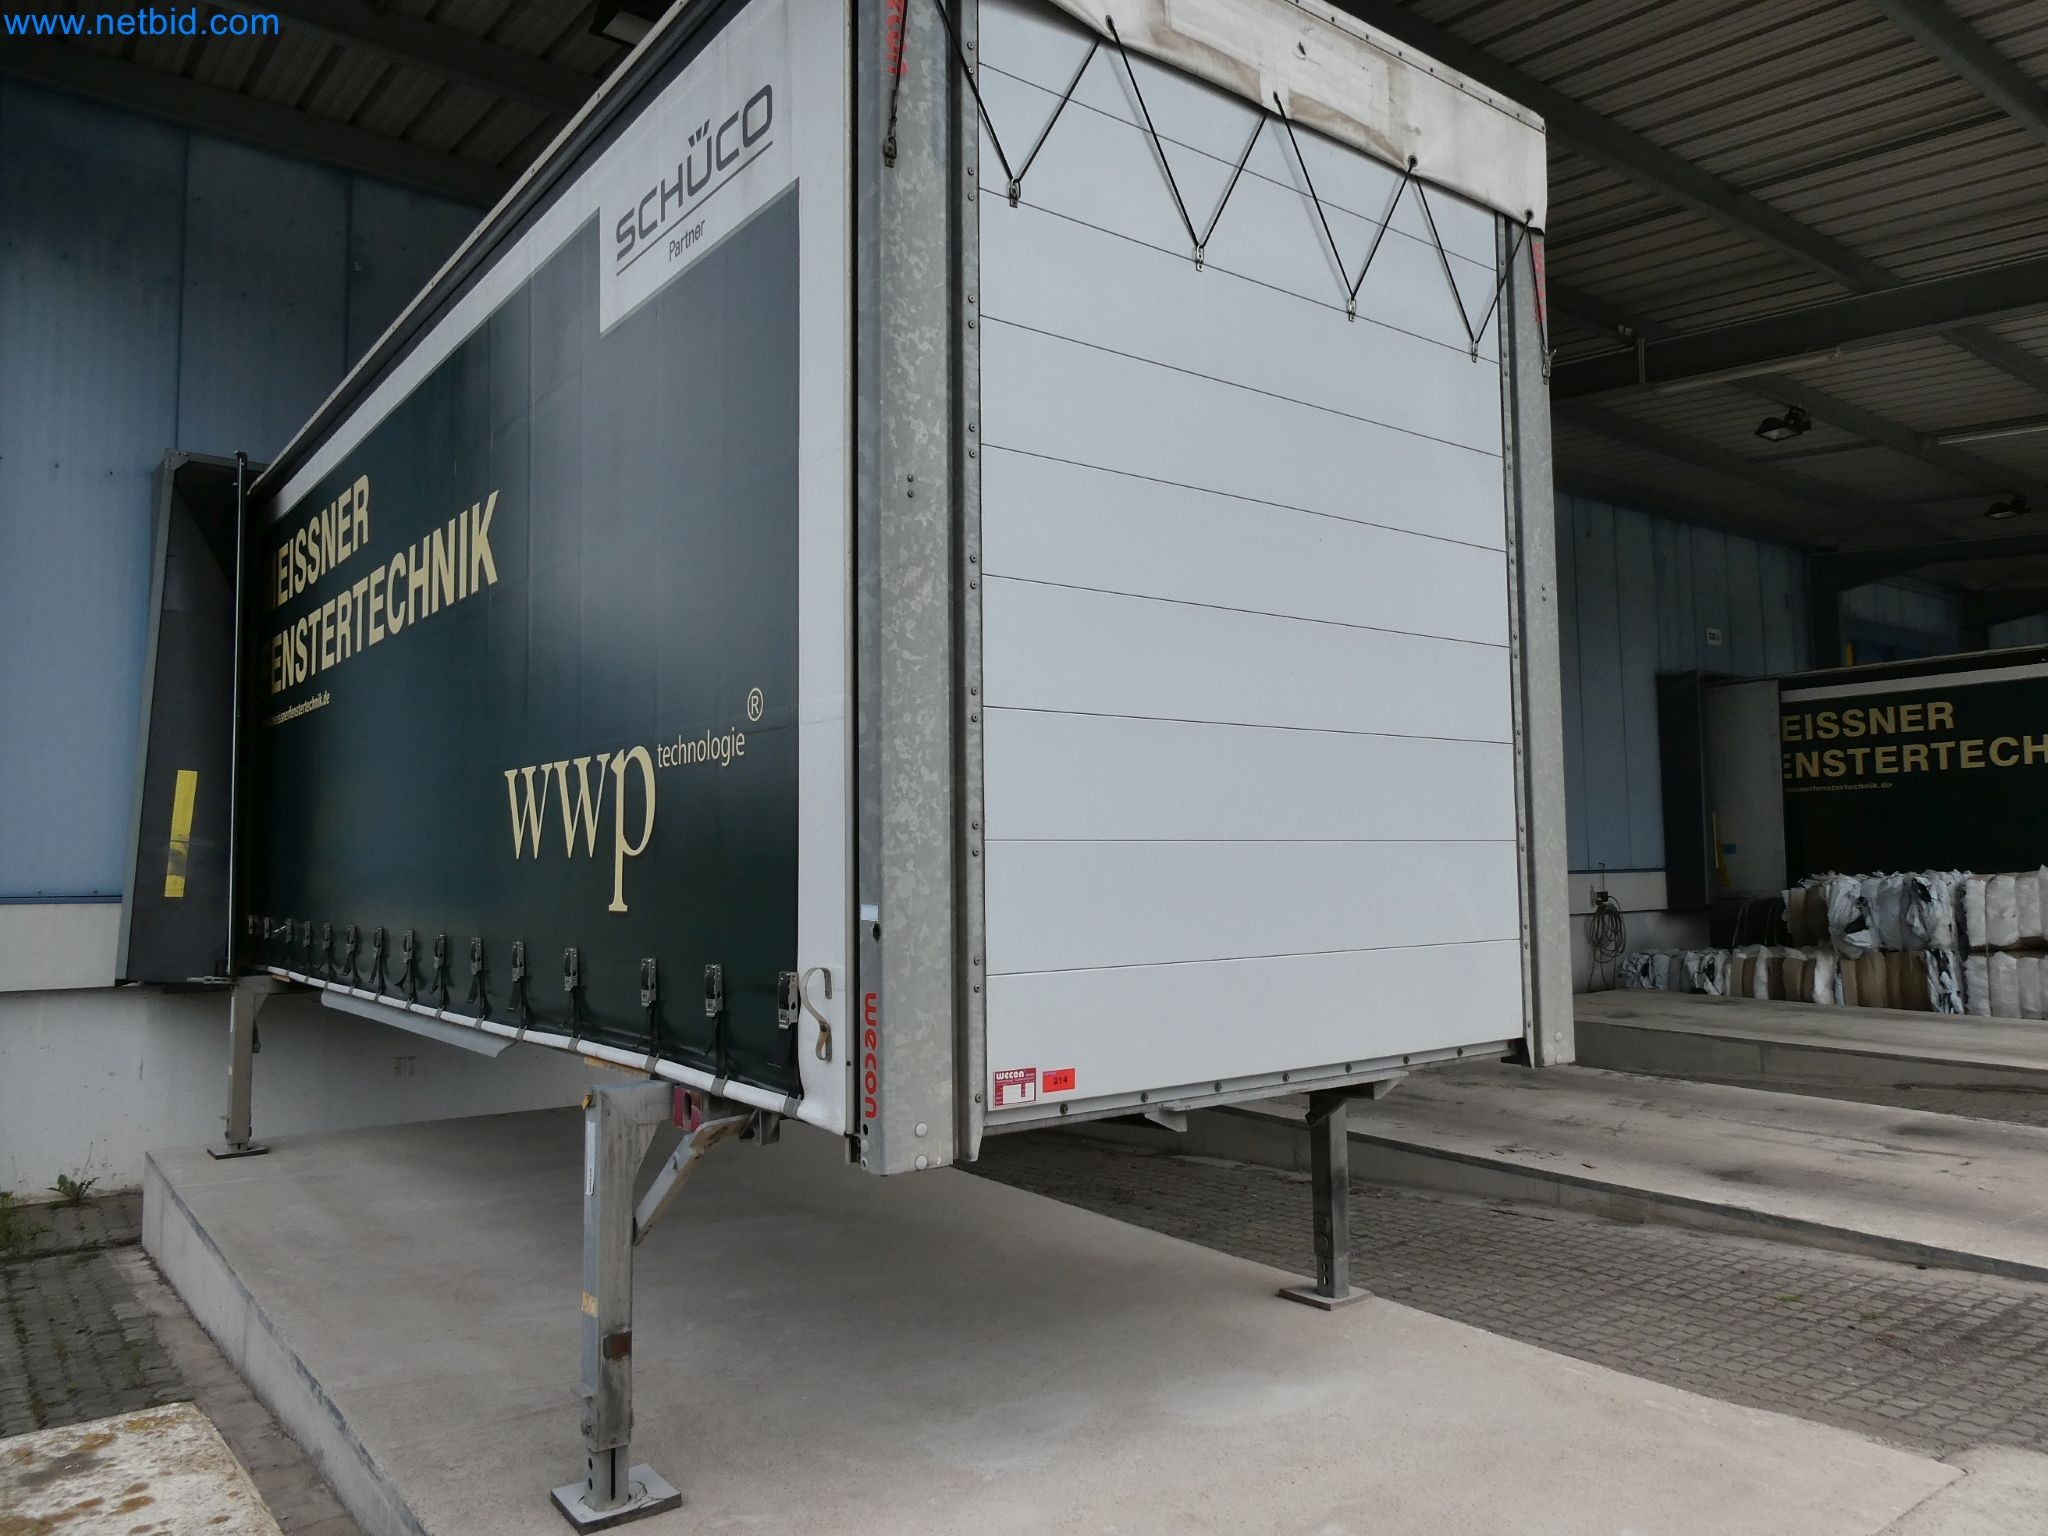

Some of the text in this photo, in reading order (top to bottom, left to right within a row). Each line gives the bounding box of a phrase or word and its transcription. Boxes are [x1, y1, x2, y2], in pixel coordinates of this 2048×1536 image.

[616, 84, 773, 262] SCHÜCO
[669, 219, 706, 262] Partner
[274, 474, 370, 608] EISSNER
[271, 489, 499, 695] ENSTERTECHNIK
[657, 726, 745, 768] technologie
[1781, 701, 1955, 742] EISSNER
[504, 745, 656, 912] wwp
[864, 992, 878, 1119] wecon
[996, 1070, 1025, 1080] wecon
[1053, 1075, 1068, 1085] 214
